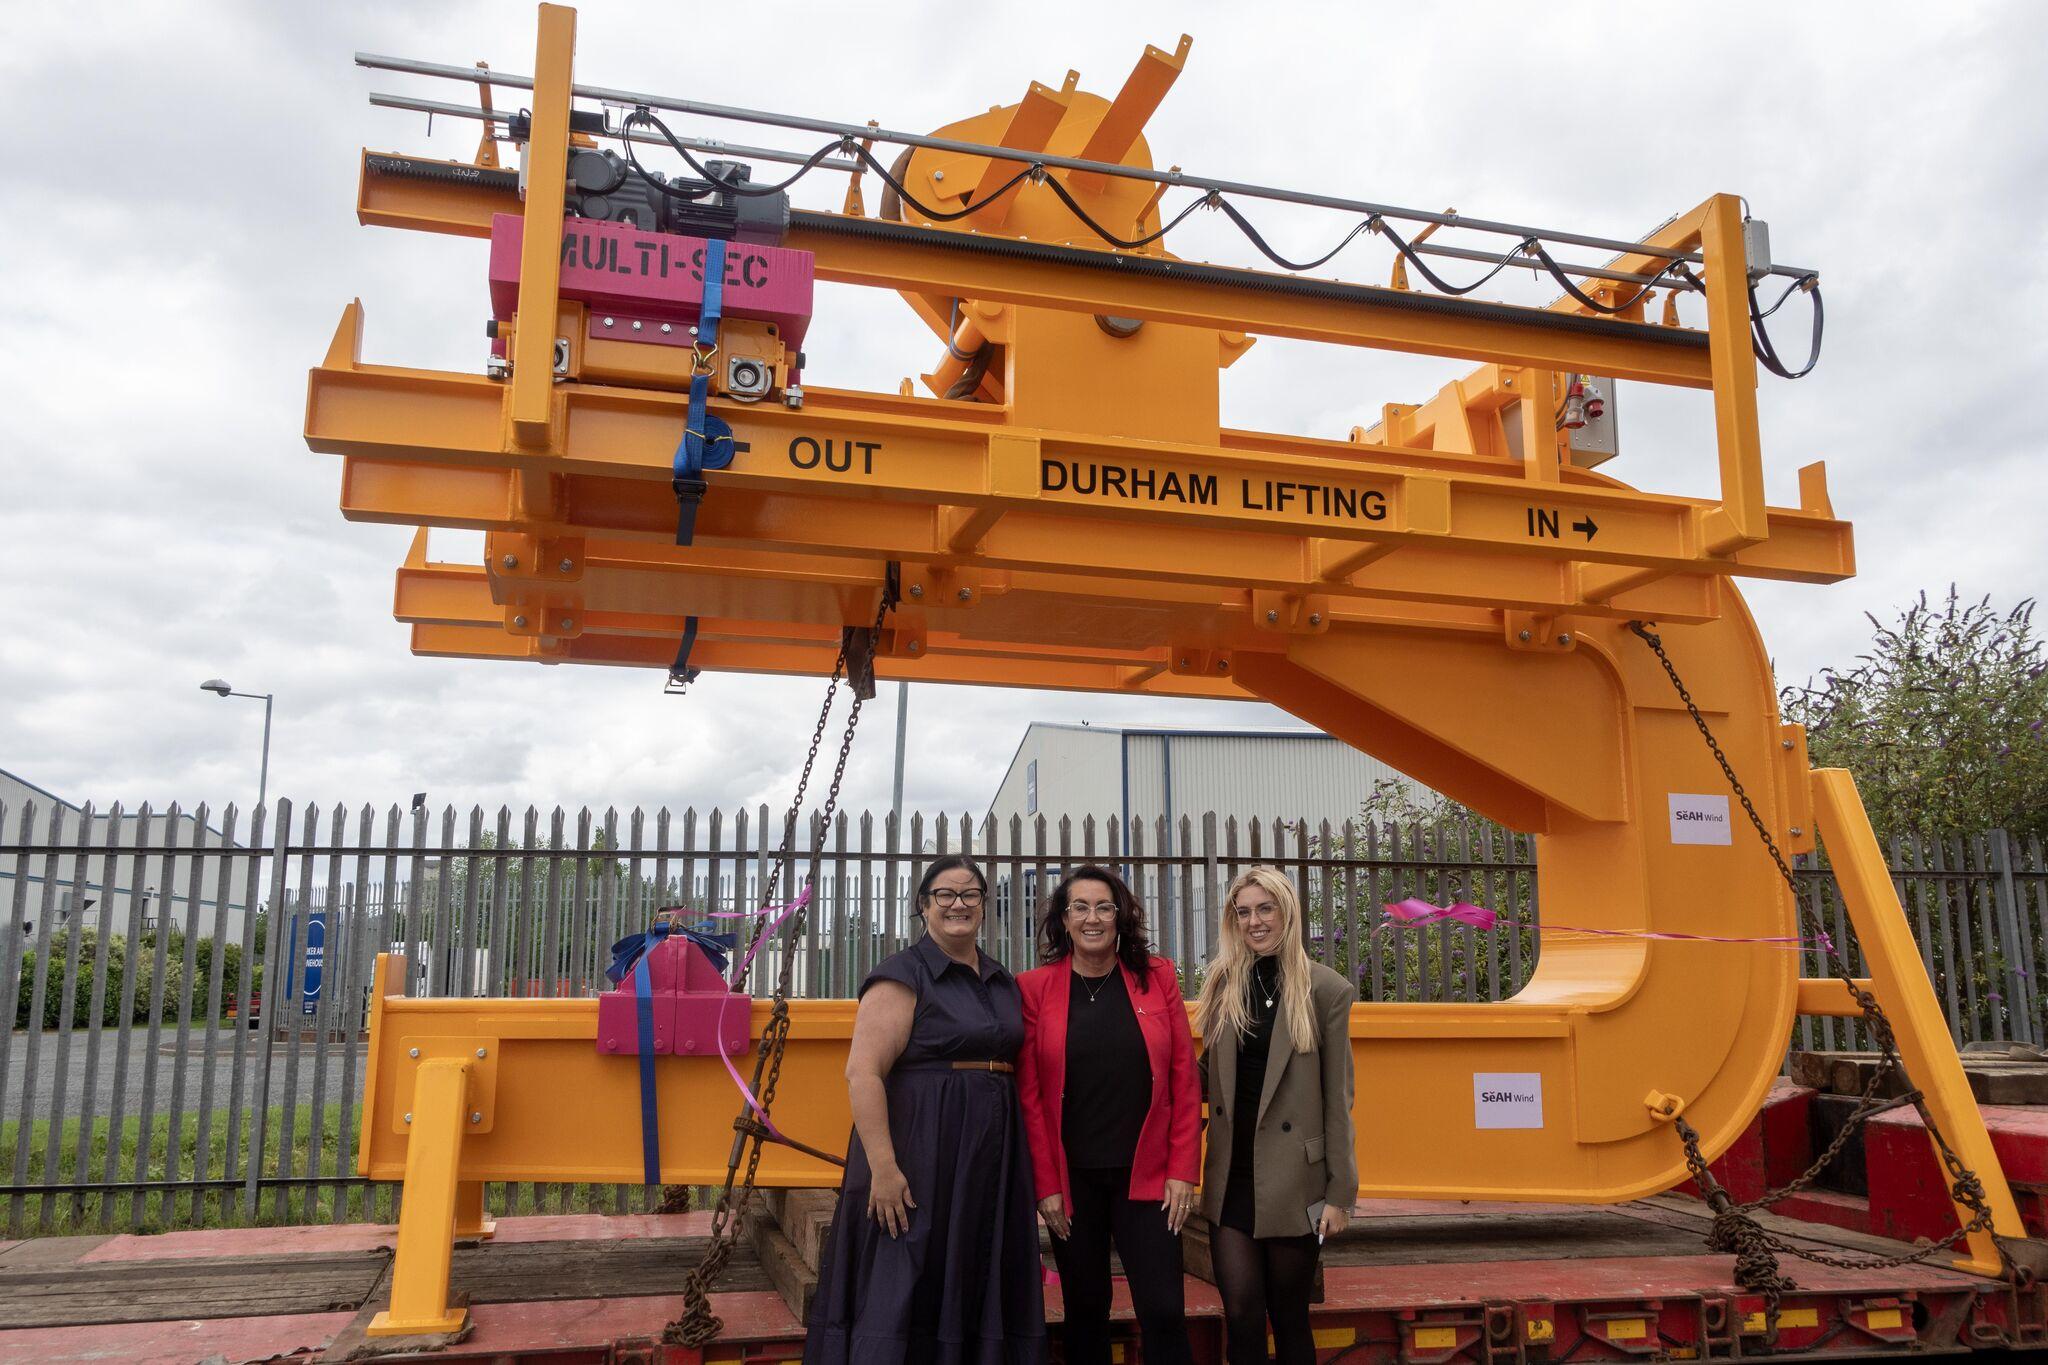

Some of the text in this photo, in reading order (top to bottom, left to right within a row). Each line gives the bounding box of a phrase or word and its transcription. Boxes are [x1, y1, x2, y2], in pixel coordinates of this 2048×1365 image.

[789, 436, 882, 474] OUT
[1042, 460, 1386, 521] DURHAM LIFTING
[1527, 508, 1559, 538] IN
[1704, 814, 1723, 822] Wind
[1513, 1093, 1534, 1102] Wind
